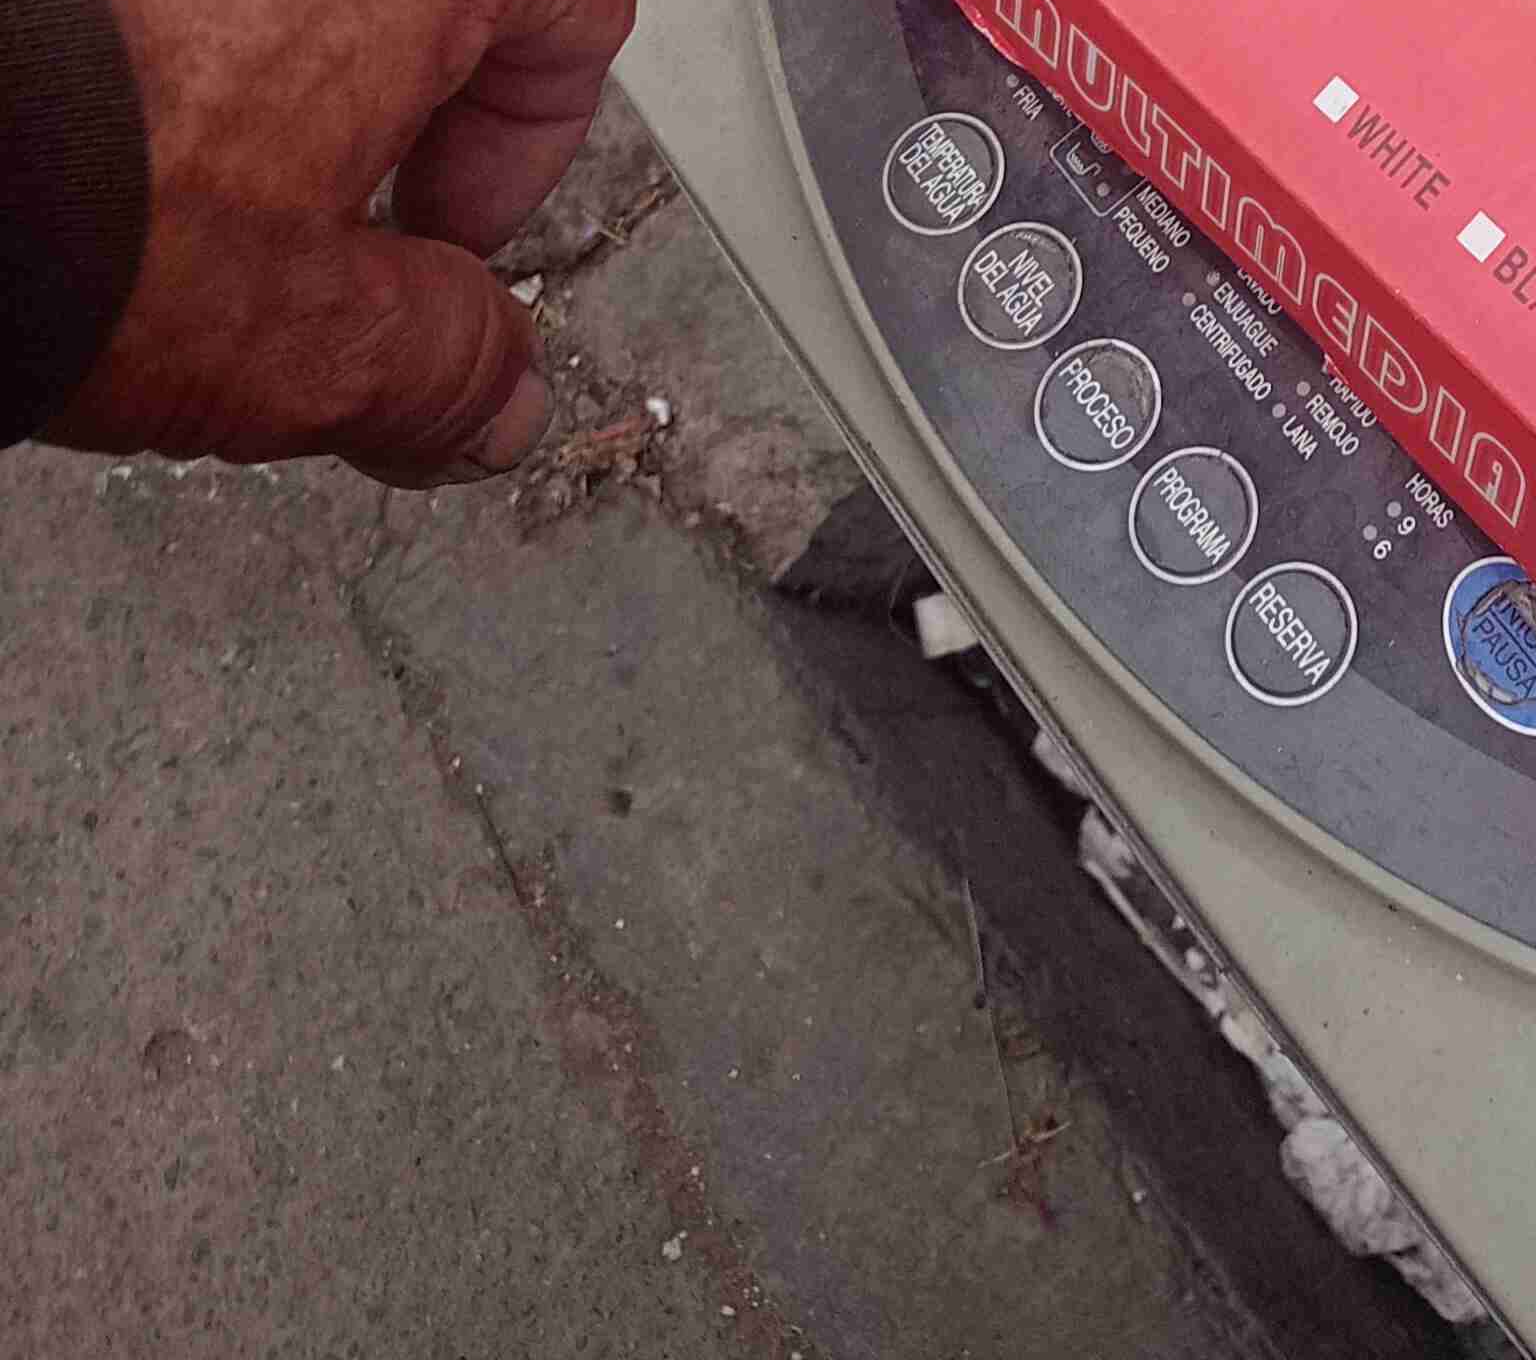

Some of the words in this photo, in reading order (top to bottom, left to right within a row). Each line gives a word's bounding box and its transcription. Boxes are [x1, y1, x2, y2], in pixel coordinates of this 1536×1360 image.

[1012, 86, 1045, 121] FRIA
[898, 142, 929, 185] DEL
[920, 174, 969, 227] AGUA
[918, 122, 988, 209] TEMPERATURA
[1346, 103, 1452, 211] WHITE
[1136, 184, 1192, 249] MEDIANO
[973, 249, 1010, 294] DEL
[995, 283, 1044, 338] AGUA
[1007, 248, 1056, 309] NIVEL
[1189, 303, 1273, 401] CENTRIFUGADO
[1212, 281, 1280, 358] ENJUAGUE
[1058, 358, 1136, 450] PROCESO
[1281, 414, 1320, 461] LANA
[1305, 393, 1360, 456] REMOJO
[1153, 467, 1232, 567] PROGRAMA
[1397, 515, 1417, 536] 9
[1403, 472, 1455, 530] HORAS
[1372, 539, 1393, 561] 6
[1247, 583, 1331, 687] RESERVA
